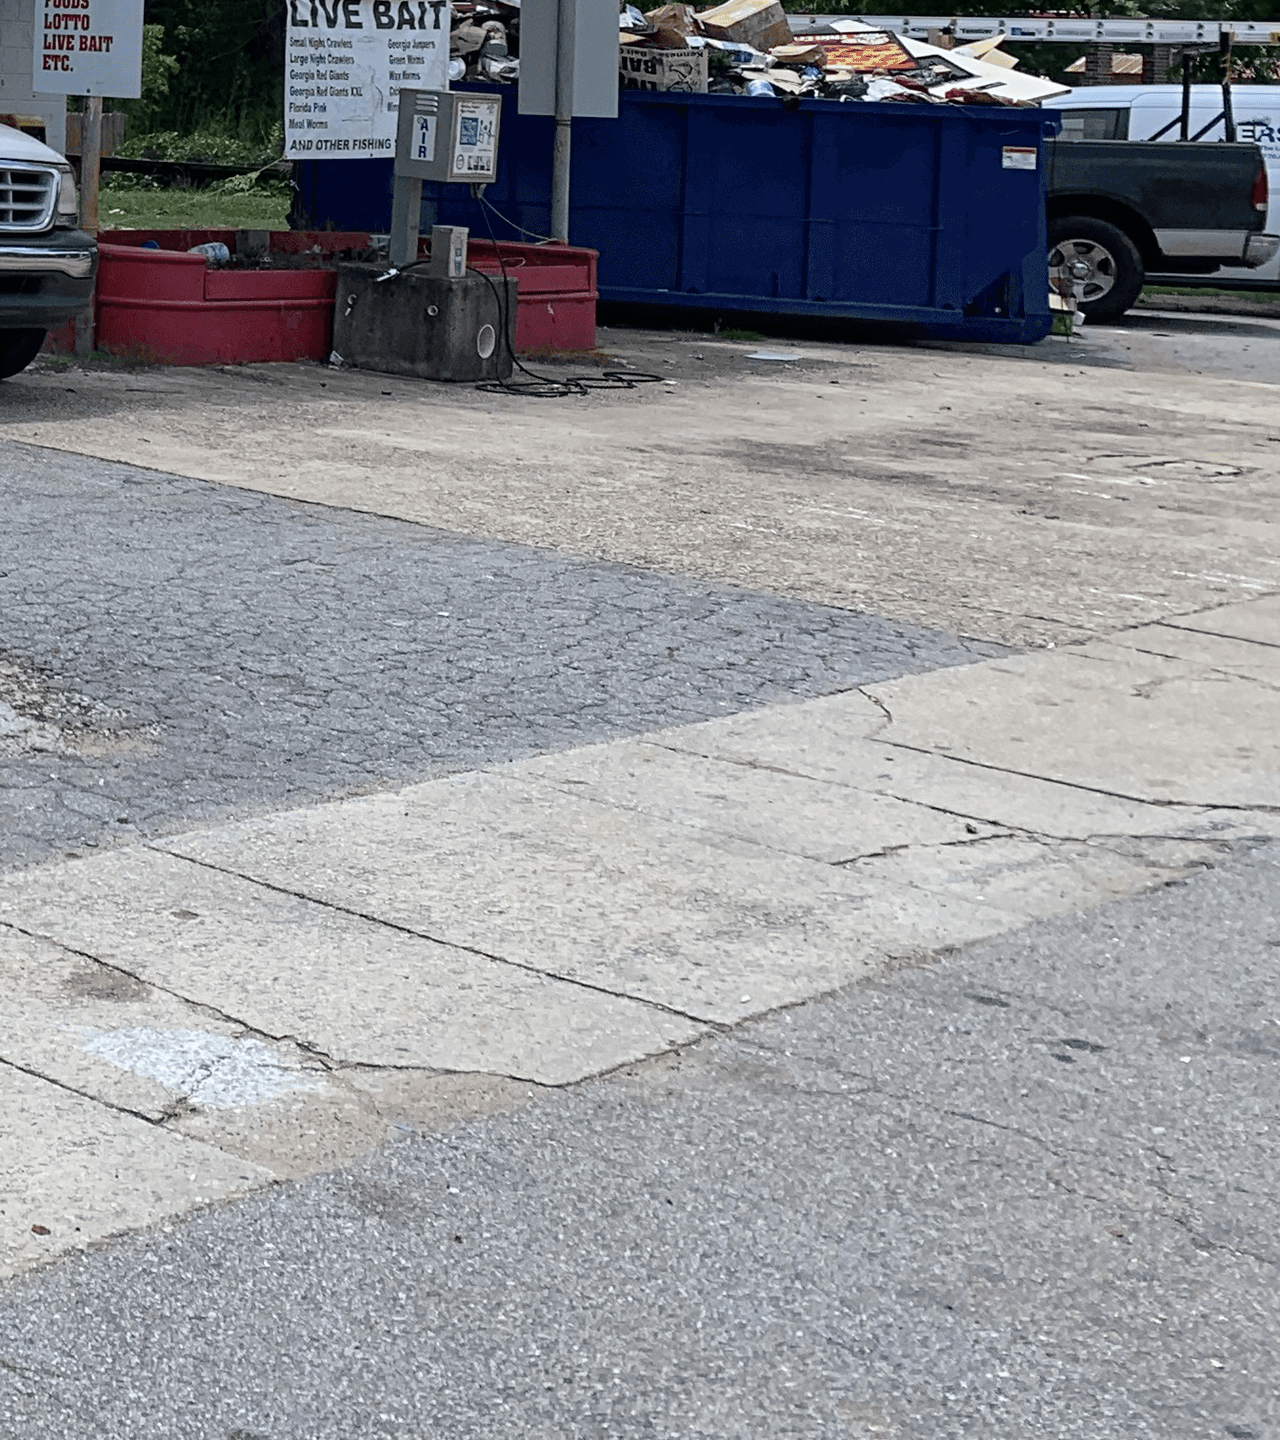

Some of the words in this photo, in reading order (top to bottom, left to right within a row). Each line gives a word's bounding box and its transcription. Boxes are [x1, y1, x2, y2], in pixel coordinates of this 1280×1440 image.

[44, 13, 90, 31] LOTTO
[372, 0, 447, 30] BAIT
[43, 33, 75, 51] LIVE
[79, 34, 114, 52] BAIT
[290, 36, 307, 48] Small
[326, 37, 353, 49] Crawlers
[388, 38, 411, 52] Georgia
[42, 53, 74, 72] ETC.
[289, 52, 309, 66] Large
[309, 53, 327, 67] Night
[327, 53, 355, 65] Crawlers
[621, 56, 657, 75] BAI
[289, 69, 315, 83] Georgia
[316, 69, 327, 80] Red
[329, 69, 350, 81] Giants
[289, 85, 315, 99] Georgia
[316, 86, 328, 97] Red
[329, 86, 349, 97] Giants
[289, 102, 312, 113] Florida
[313, 102, 327, 113] Pink
[288, 118, 305, 129] Meal
[306, 118, 329, 130] Worms
[290, 139, 313, 151] AND
[315, 139, 350, 151] OTHER
[352, 137, 392, 150] FISHING
[418, 118, 429, 159] AIR
